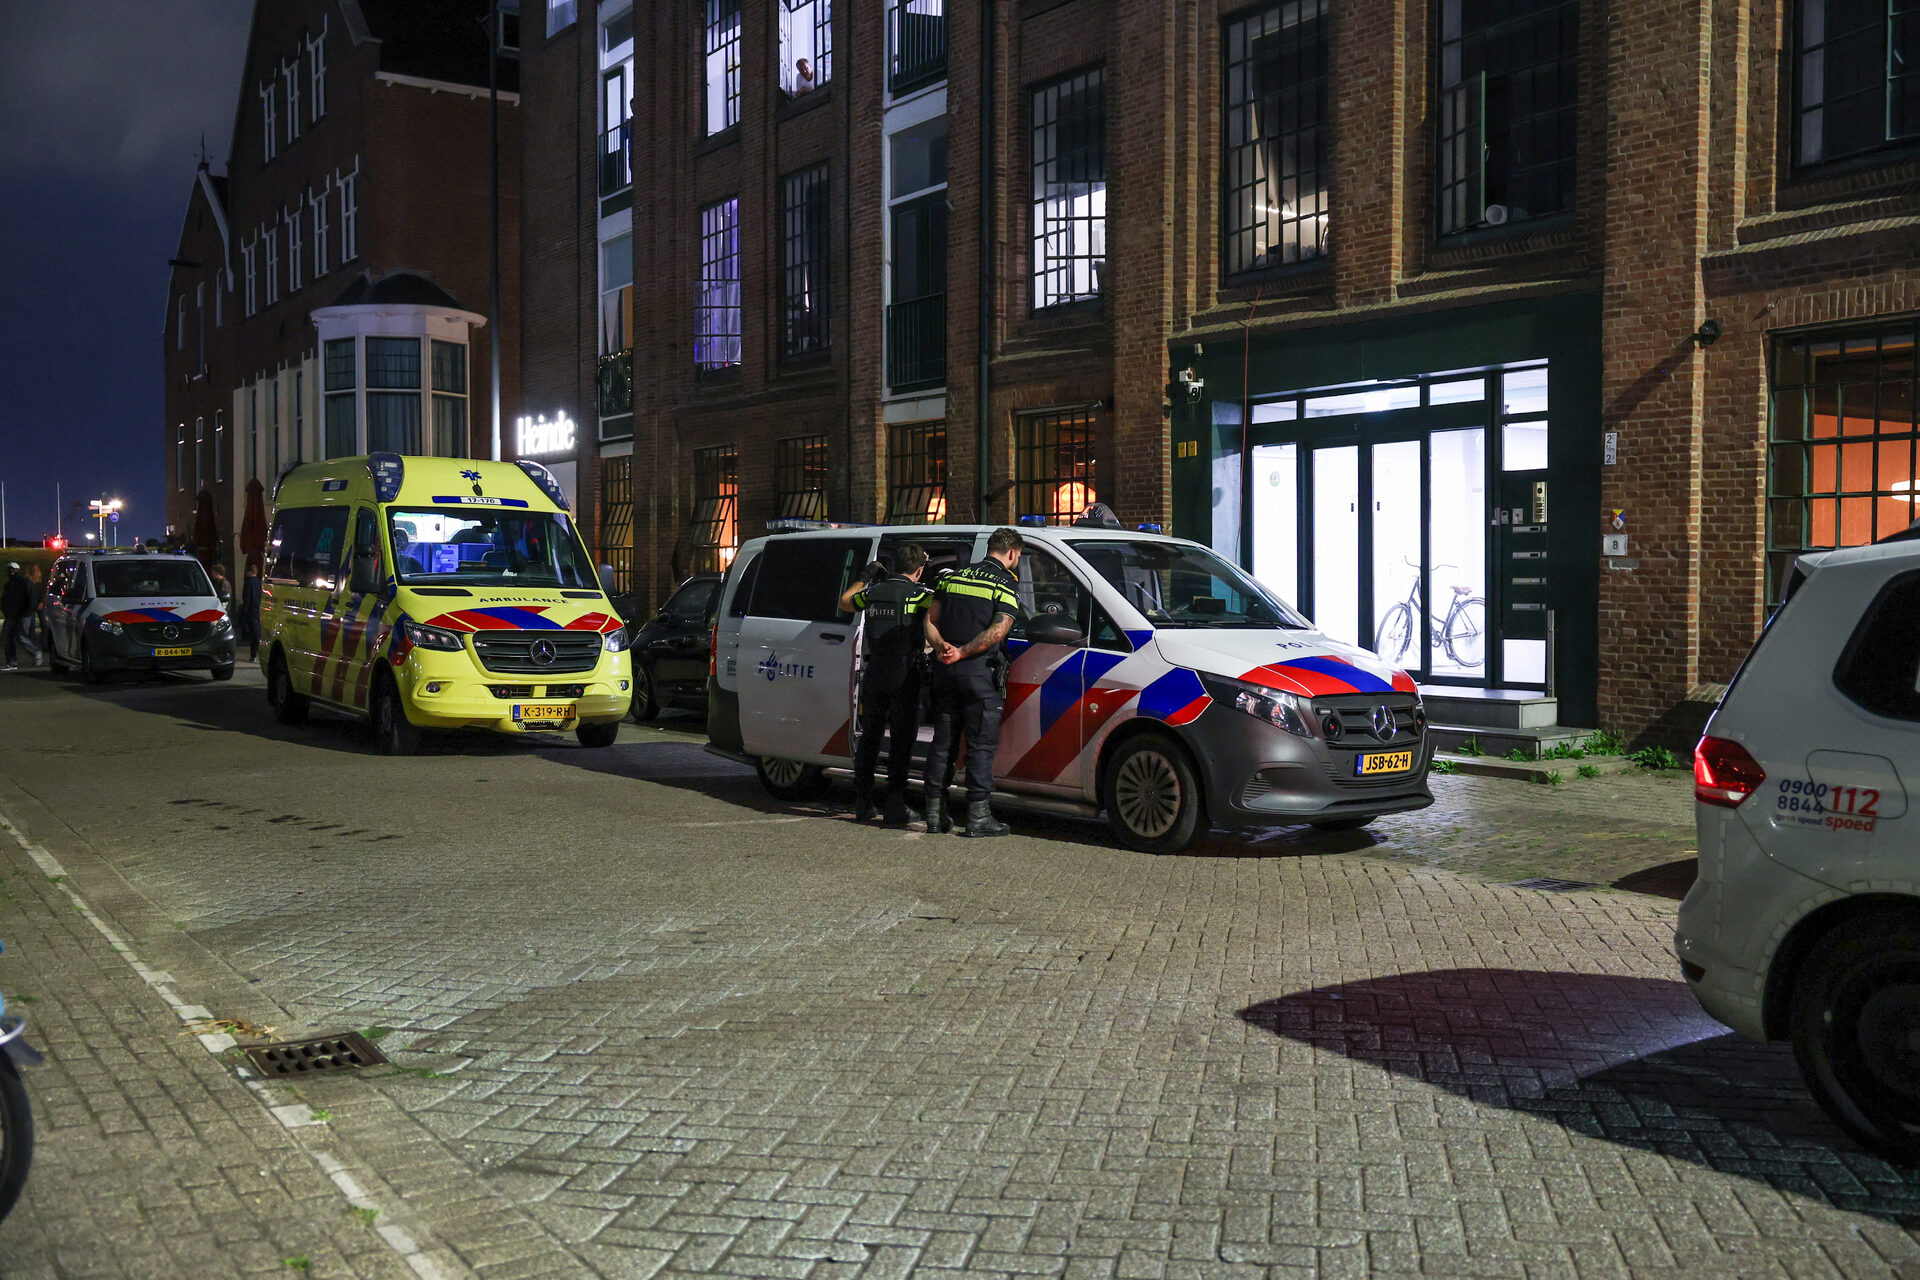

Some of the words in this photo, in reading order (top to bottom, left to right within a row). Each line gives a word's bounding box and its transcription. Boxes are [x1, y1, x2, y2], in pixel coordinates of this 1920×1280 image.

[517, 410, 575, 456] Heinde
[958, 567, 995, 580] POLITIE
[866, 606, 895, 617] POLITIE
[759, 656, 814, 681] POLITIE
[524, 706, 571, 717] K-319-RH
[1366, 754, 1409, 771] JSB-62-H
[1780, 779, 1827, 797] 0900
[1777, 795, 1824, 815] 8844
[1831, 785, 1880, 816] 112
[1825, 816, 1875, 832] spoed
